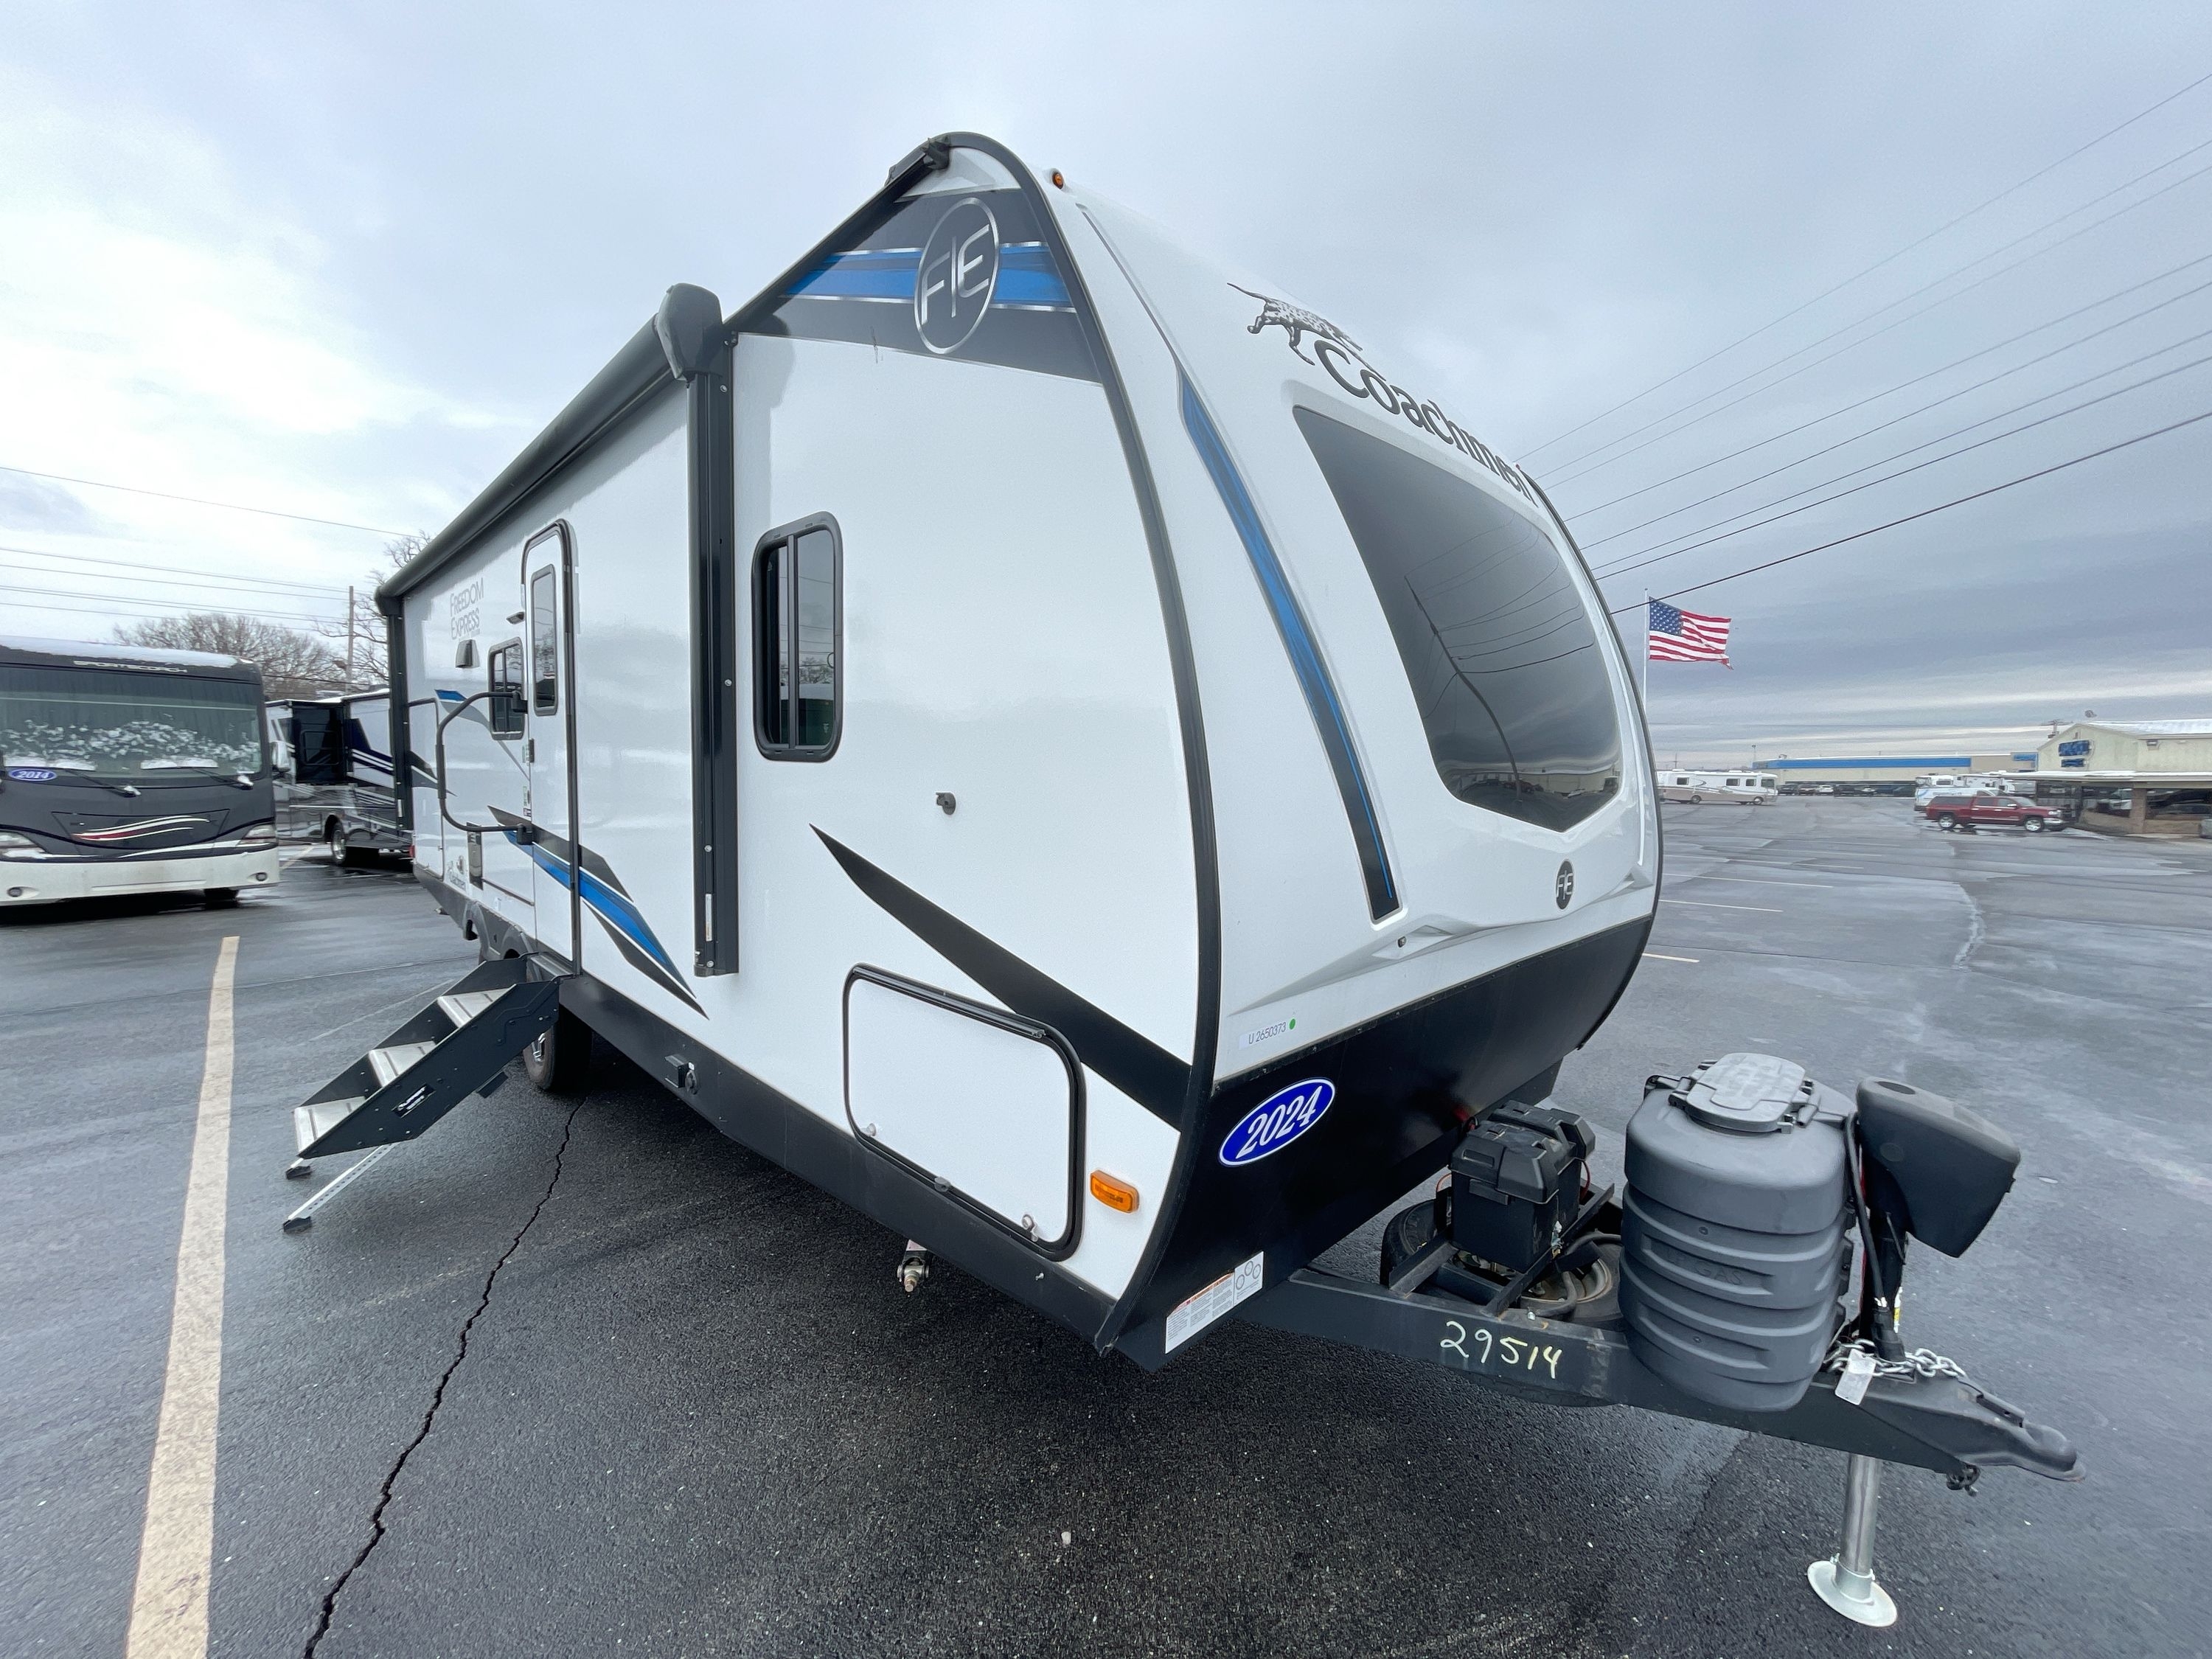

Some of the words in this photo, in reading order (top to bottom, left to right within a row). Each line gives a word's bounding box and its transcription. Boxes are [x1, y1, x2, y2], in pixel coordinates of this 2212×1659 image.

[1314, 340, 1539, 507] Coachmen
[450, 577, 484, 617] FREEDOM
[451, 608, 480, 640] EXPRESS
[16, 771, 49, 779] 2014
[1248, 1033, 1255, 1045] U
[1255, 1021, 1287, 1043] 2650373
[1235, 1085, 1323, 1159] 2024
[1440, 1321, 1562, 1379] 29514
